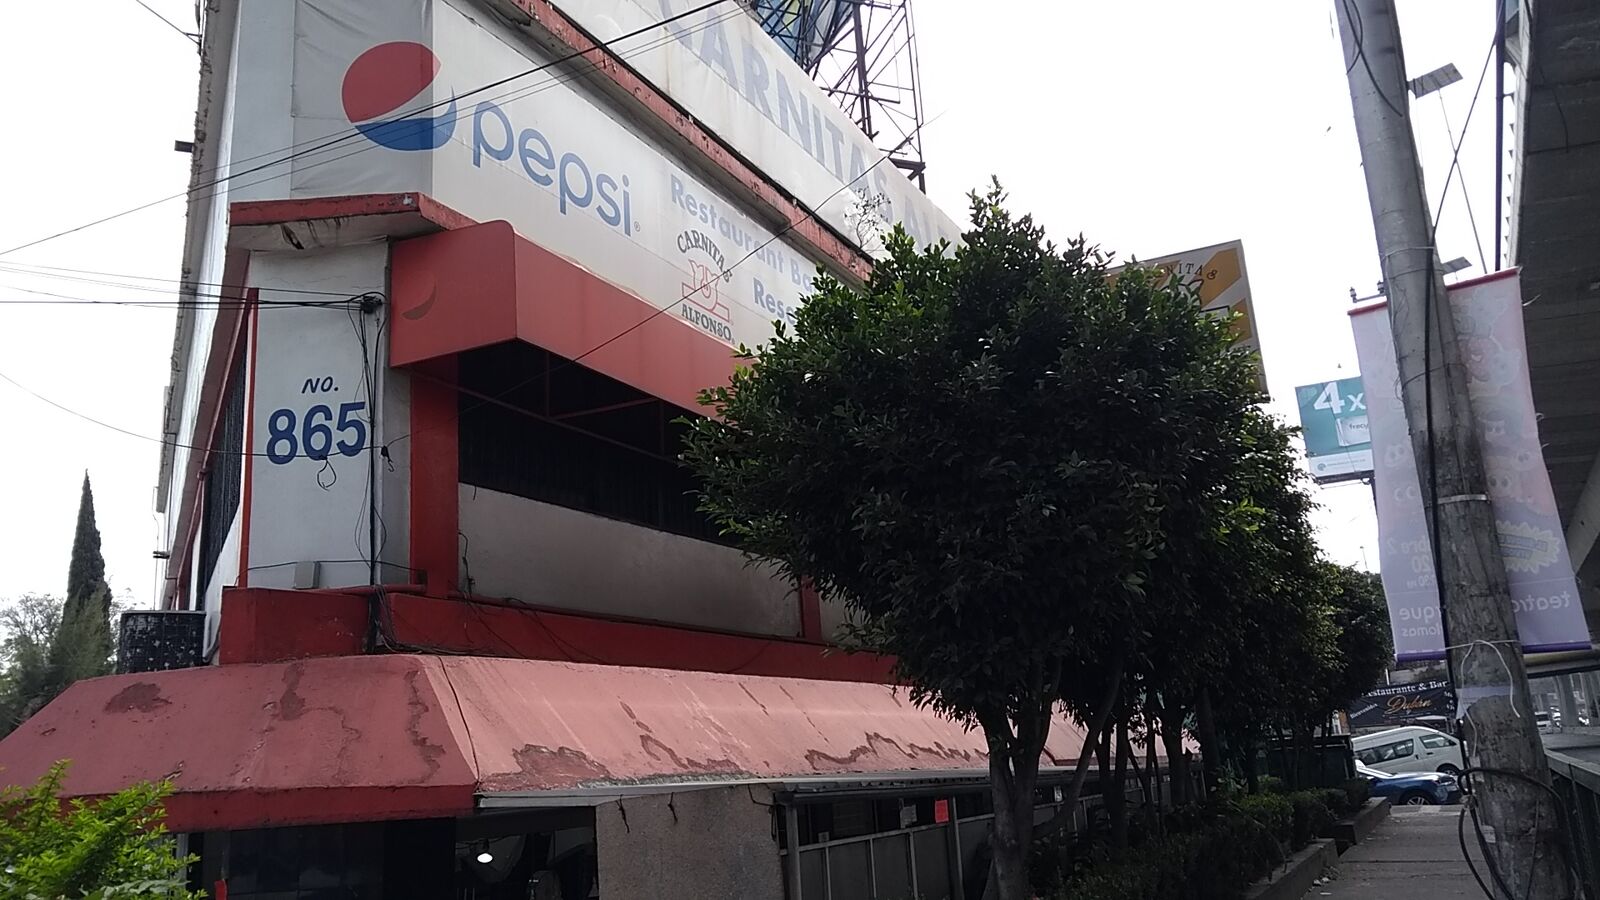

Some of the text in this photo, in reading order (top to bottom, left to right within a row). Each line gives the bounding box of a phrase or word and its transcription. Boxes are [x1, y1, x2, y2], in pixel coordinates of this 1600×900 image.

[472, 100, 632, 237] pepsi
[671, 174, 813, 294] Restaurant Ba
[681, 302, 732, 342] ALFONSO
[753, 276, 797, 326] Rese
[266, 402, 366, 465] 865
[1429, 680, 1449, 690] Bar
